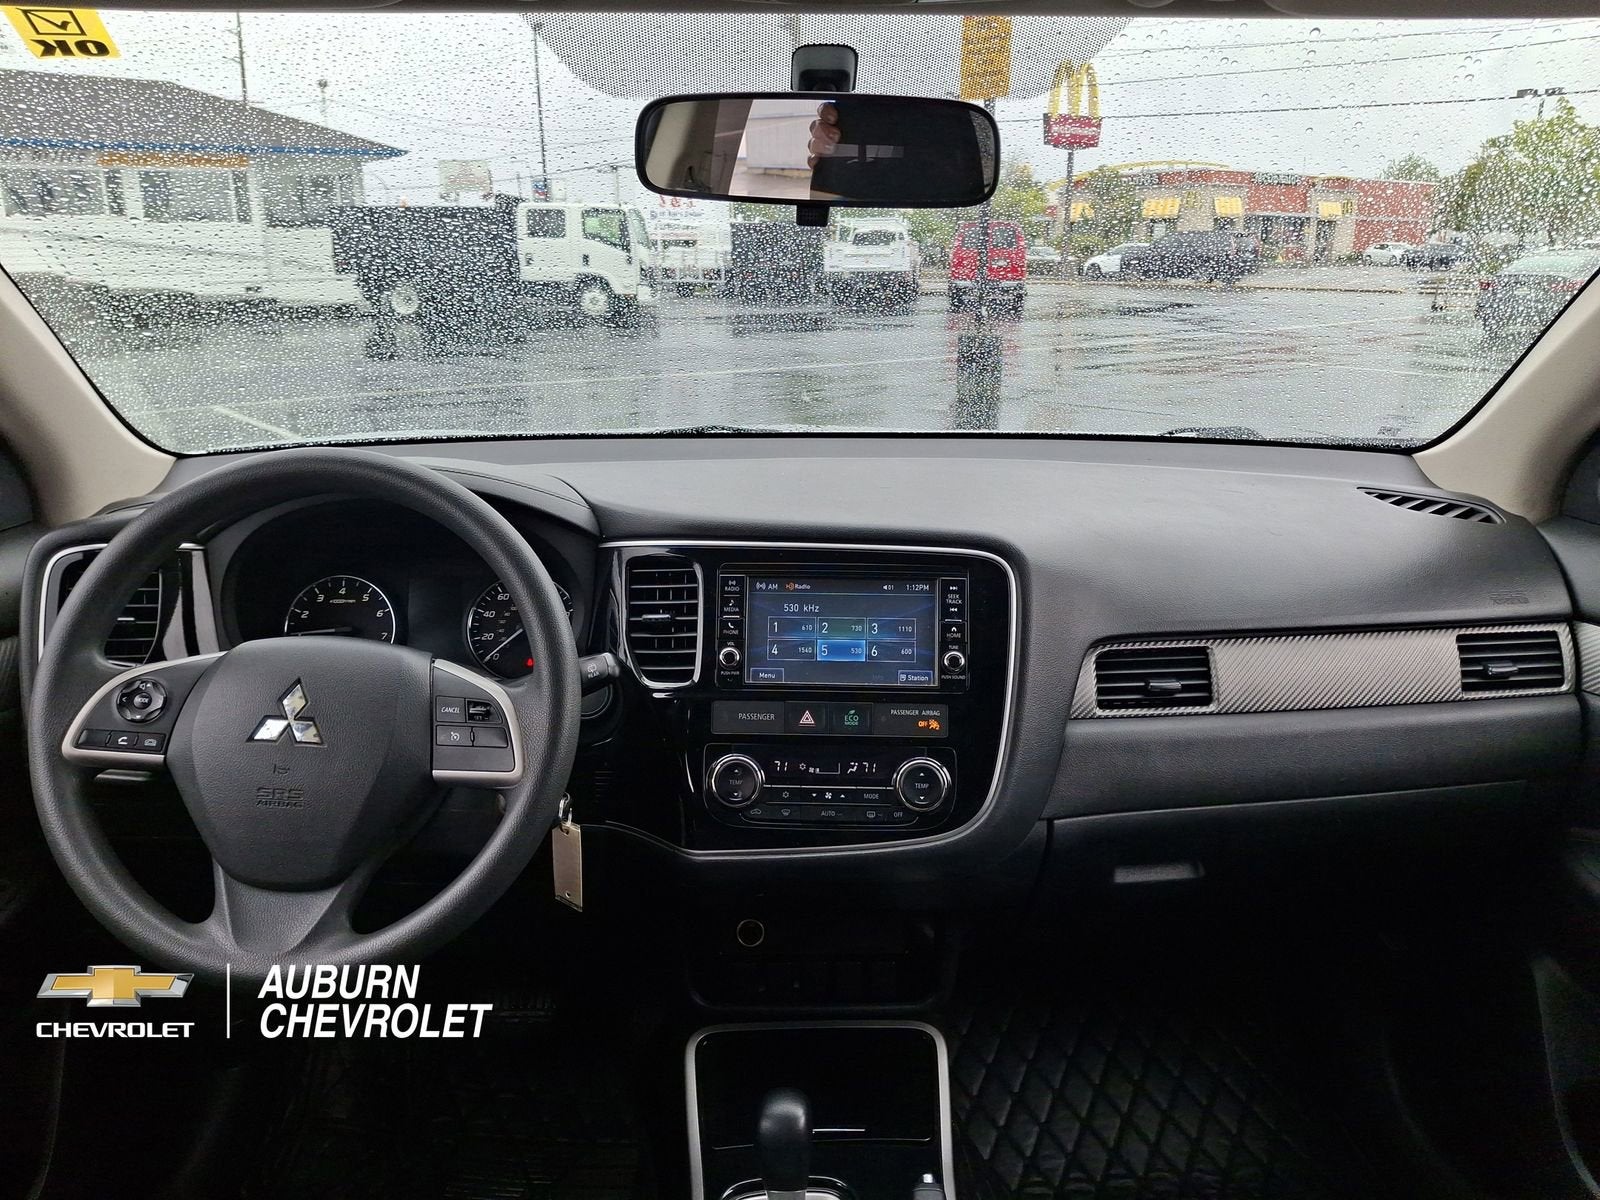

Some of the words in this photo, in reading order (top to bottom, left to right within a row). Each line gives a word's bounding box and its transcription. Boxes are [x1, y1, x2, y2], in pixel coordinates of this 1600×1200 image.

[317, 594, 325, 602] 3
[362, 594, 370, 602] 5
[497, 593, 510, 601] 60
[784, 603, 799, 612] 530
[803, 604, 820, 612] kHz
[773, 621, 778, 633] 1
[821, 622, 829, 634] 2
[871, 623, 878, 635] 3
[381, 632, 388, 640] 7
[481, 633, 494, 641] 20
[771, 644, 778, 655] 4
[821, 645, 828, 656] 5
[871, 645, 878, 657] 6
[907, 674, 929, 682] Station
[441, 706, 460, 714] CANCEL
[738, 713, 775, 721] PASSENGER
[844, 714, 859, 722] ECO
[918, 720, 928, 728] OFF
[774, 760, 789, 772] 71
[862, 762, 877, 773] 71
[256, 786, 303, 800] SRS
[256, 799, 304, 809] AIRBAG
